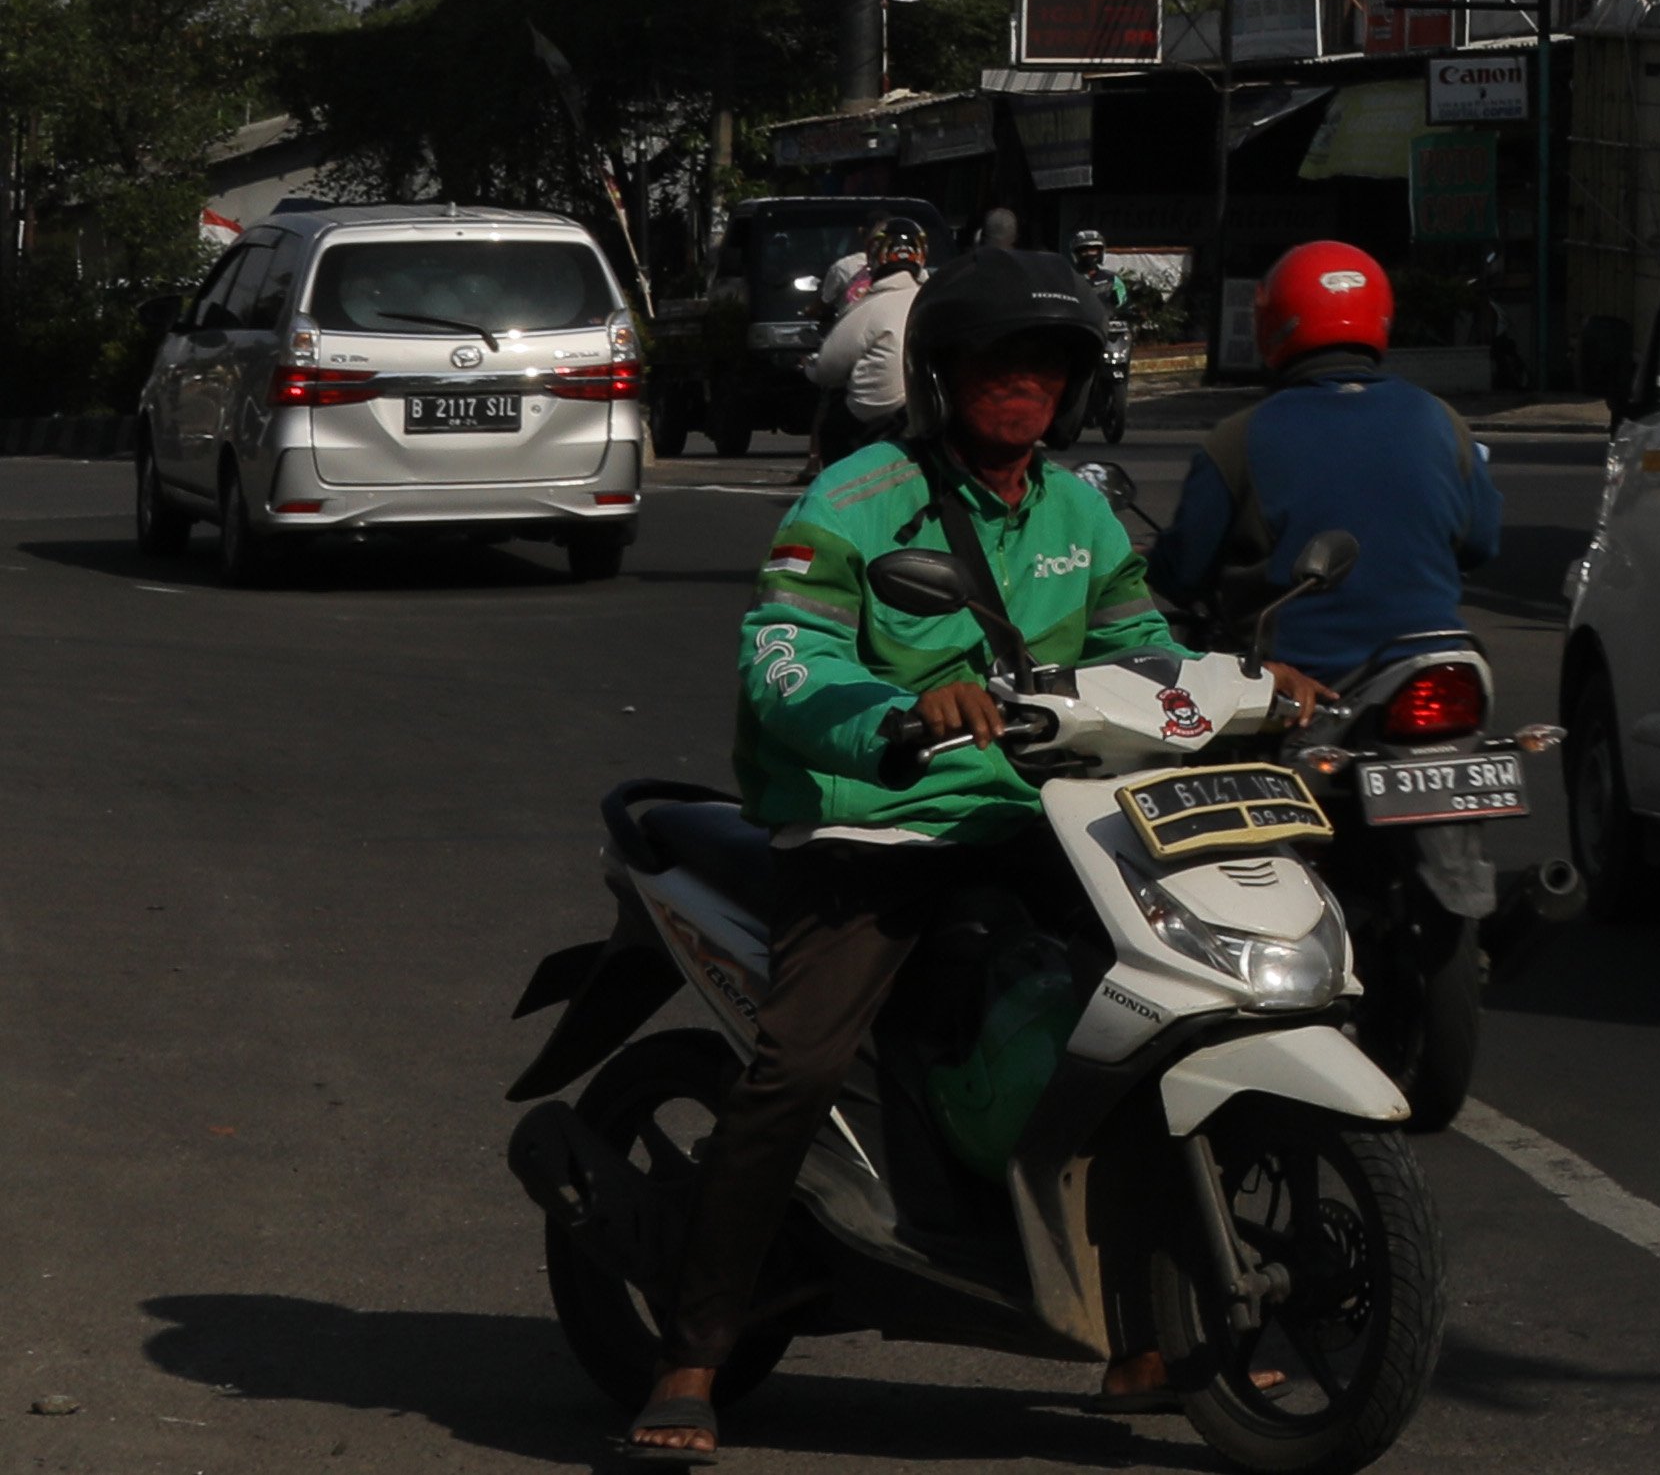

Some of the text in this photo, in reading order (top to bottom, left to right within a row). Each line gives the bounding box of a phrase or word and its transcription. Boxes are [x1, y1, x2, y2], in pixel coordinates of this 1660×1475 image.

[1438, 66, 1523, 86] Canon
[1420, 193, 1488, 233] COPY
[411, 399, 517, 418] B 2117 SIL
[1369, 761, 1516, 796] B 3137 SRW
[1135, 792, 1160, 819] B
[1173, 775, 1244, 808] 6147
[1103, 986, 1163, 1024] HONDA
